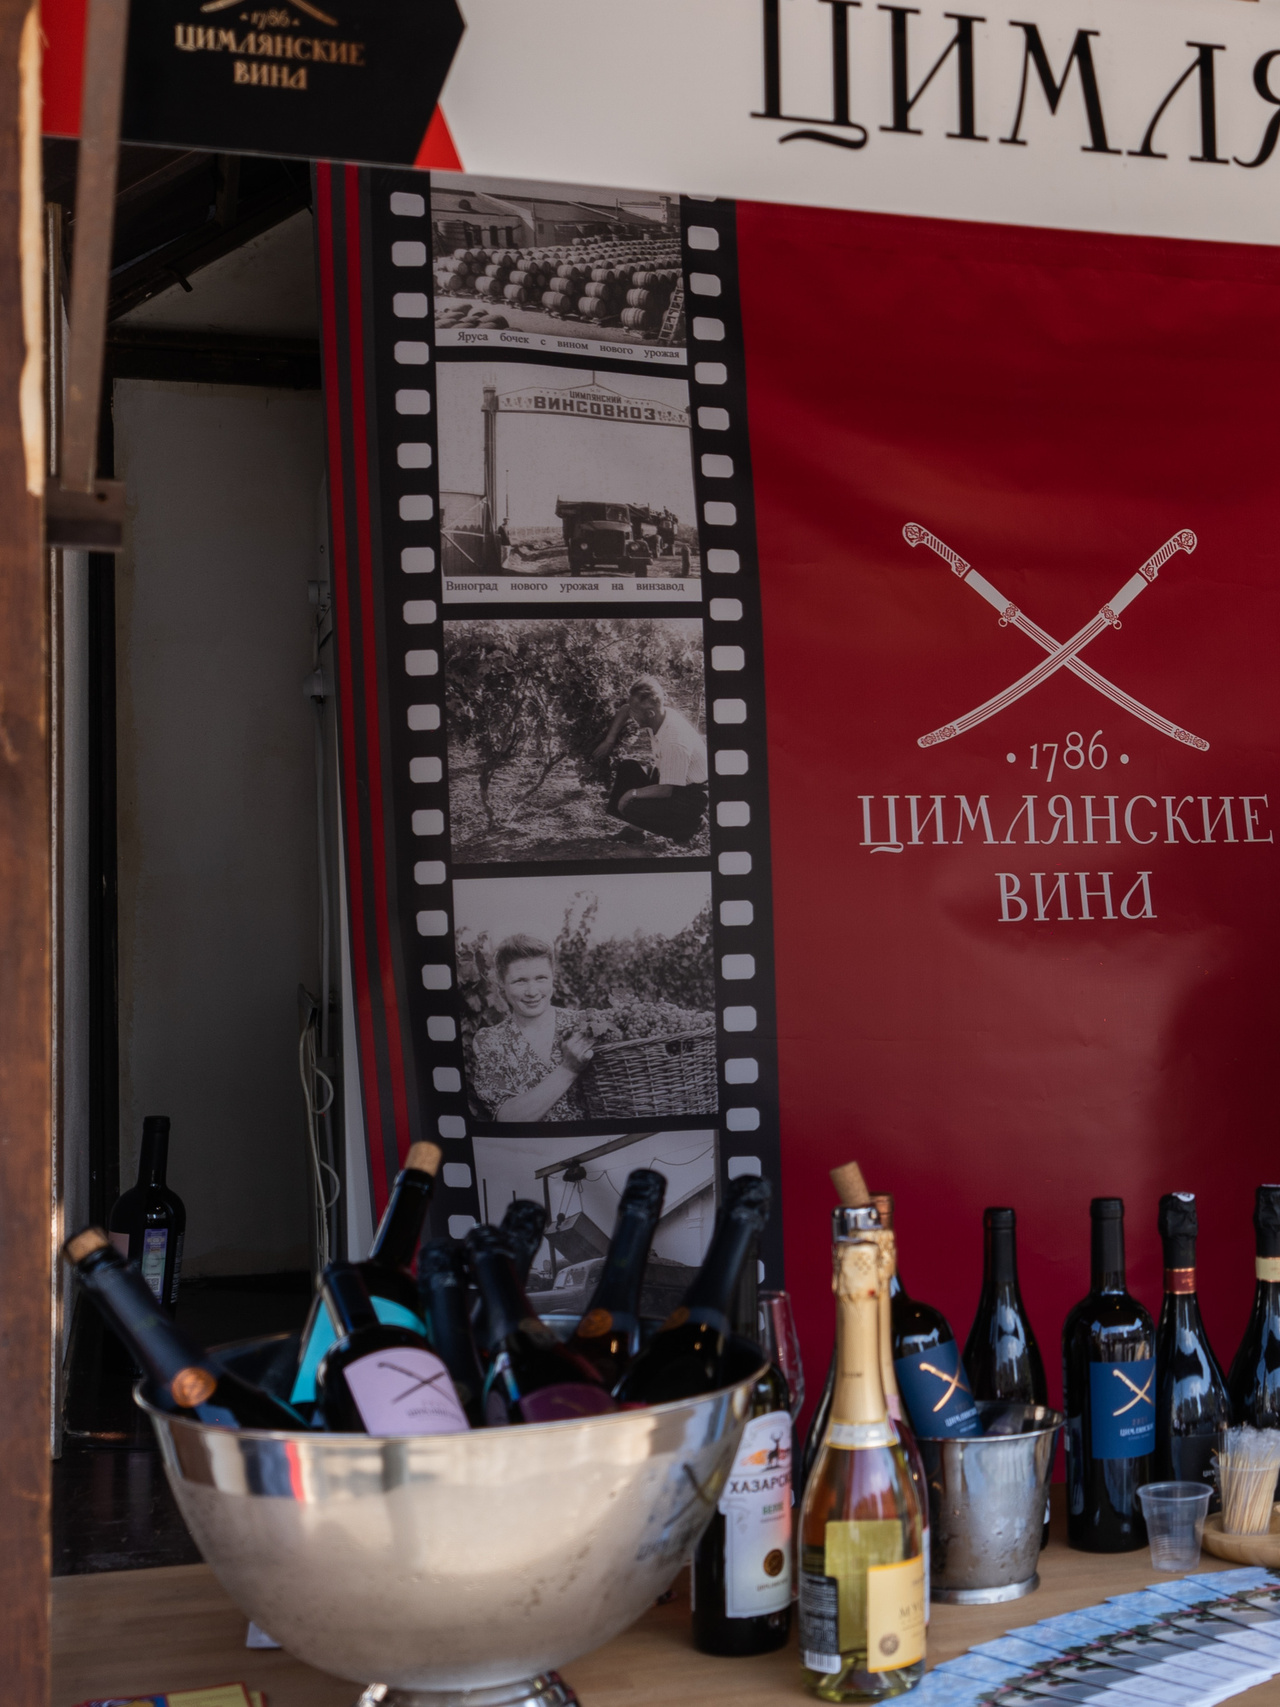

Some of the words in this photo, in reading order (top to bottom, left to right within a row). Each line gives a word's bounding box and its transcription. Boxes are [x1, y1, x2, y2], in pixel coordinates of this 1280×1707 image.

[174, 23, 366, 66] ЦИМЛЯНСКИЕ
[233, 60, 308, 90] ВИНА
[457, 331, 489, 343] Яруса
[499, 332, 530, 344] бочек
[540, 338, 547, 346] с
[557, 339, 589, 350] вином
[599, 344, 634, 355] нового
[644, 348, 680, 359] урожая
[533, 395, 657, 421] ВИНСОВХОЗ
[569, 389, 622, 404] ЦИМЛЯНСКИЙ
[446, 580, 499, 593] Виноград
[510, 582, 548, 592] нового
[559, 582, 600, 593] урожая
[611, 582, 625, 591] на
[636, 581, 685, 593] винзавод
[1029, 729, 1109, 783] 1786
[857, 794, 1275, 854] ЦИМЛЯНСКИЕ
[994, 870, 1159, 923] ВИНА
